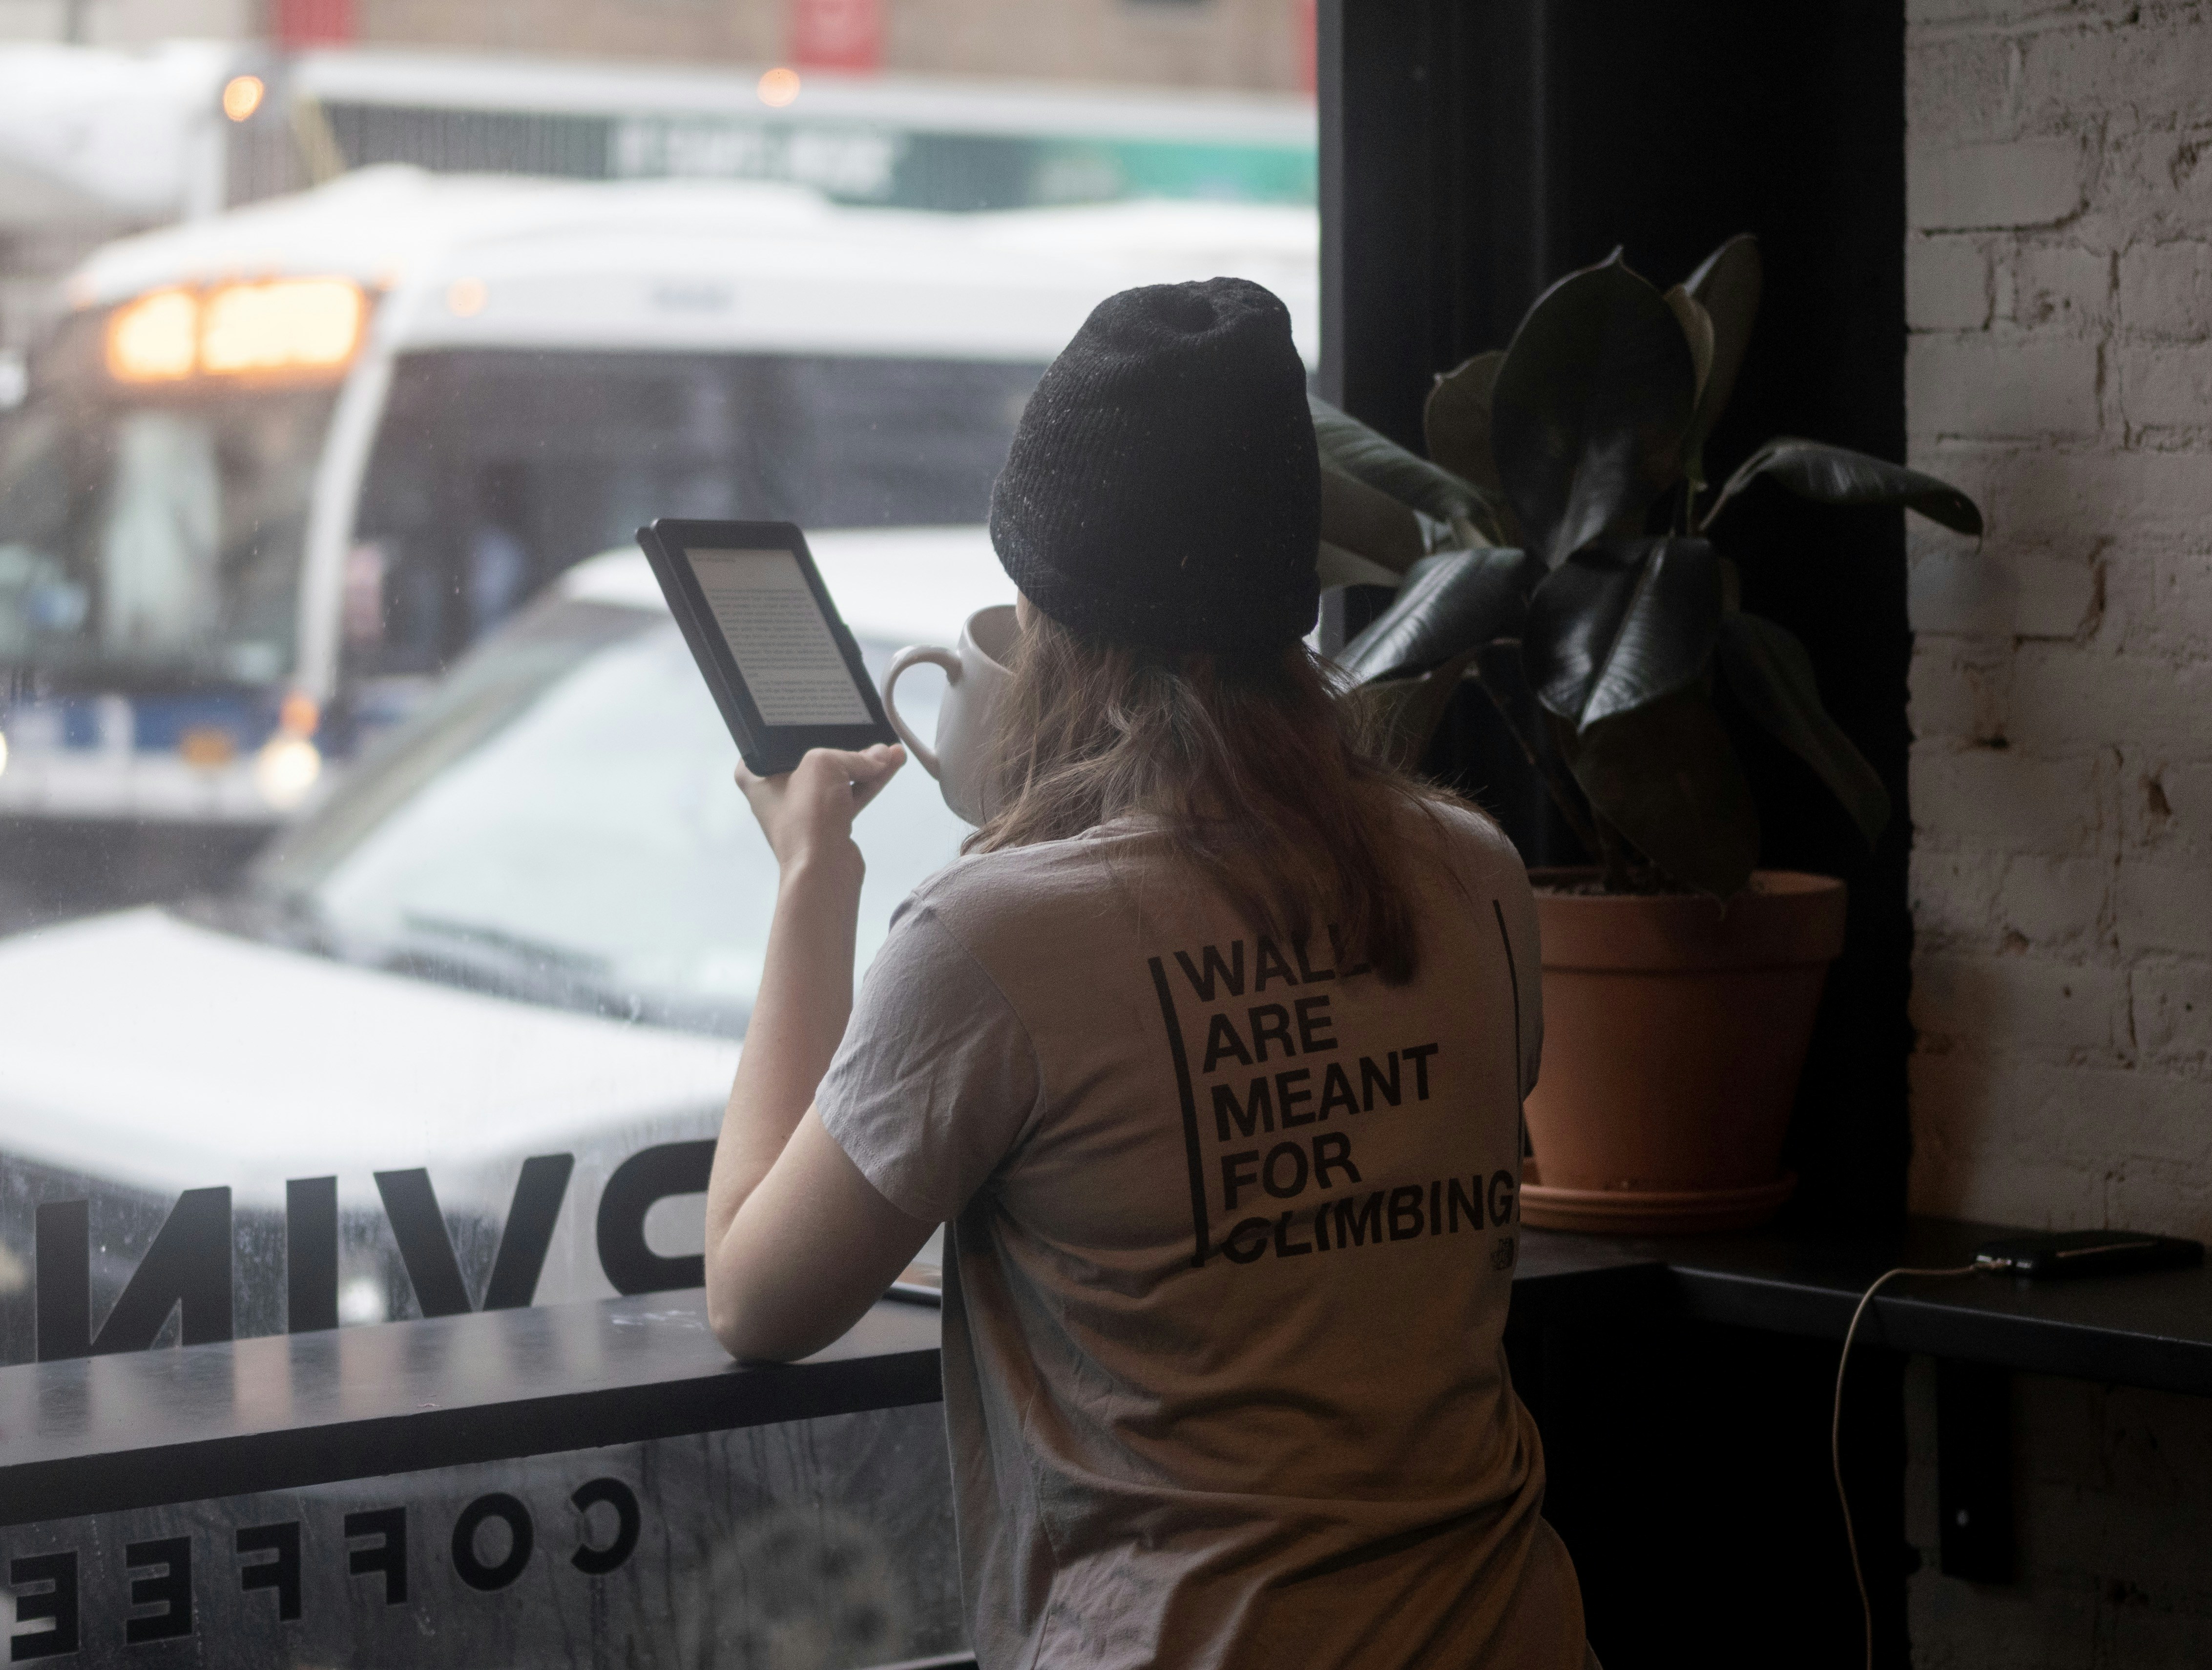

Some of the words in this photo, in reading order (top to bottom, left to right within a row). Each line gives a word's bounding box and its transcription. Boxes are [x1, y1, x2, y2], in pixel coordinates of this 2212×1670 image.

[1173, 924, 1371, 1003] WALL
[1203, 994, 1338, 1073] ARE
[1211, 1042, 1439, 1142] MEANT
[1221, 1131, 1362, 1211] FOR
[1220, 1170, 1514, 1264] CLIMBING
